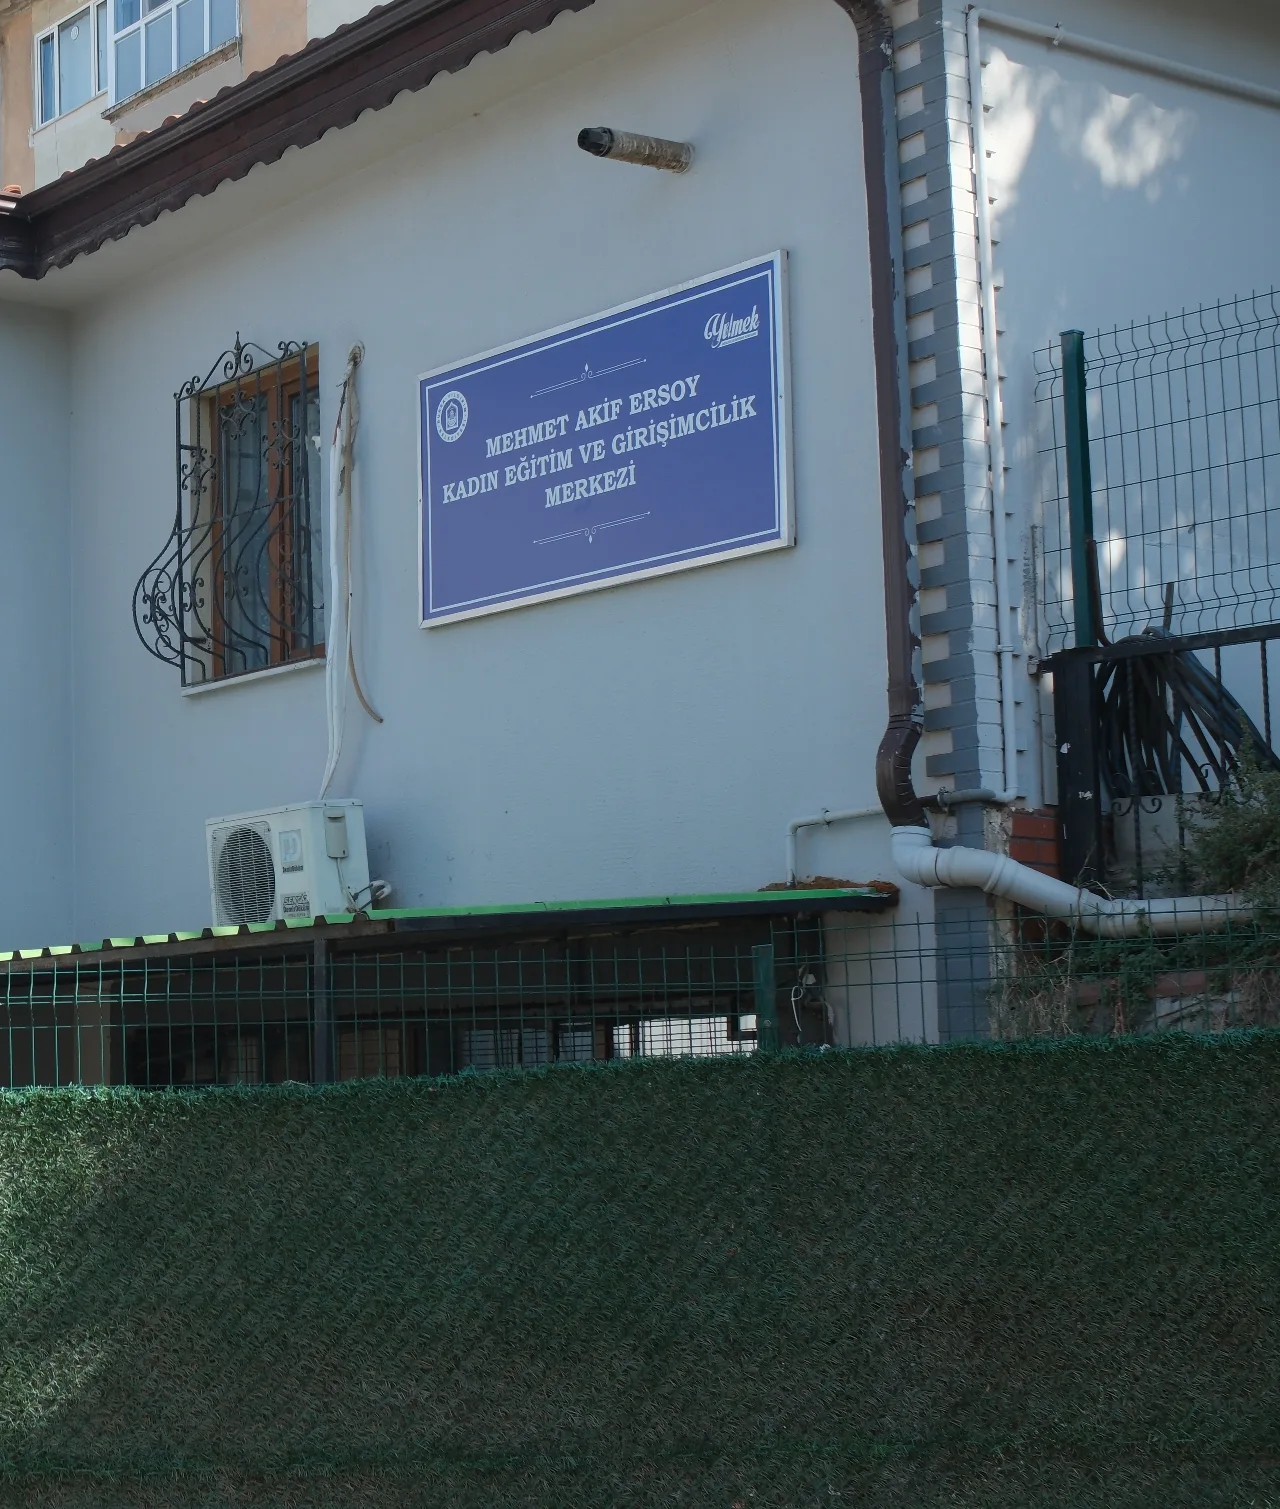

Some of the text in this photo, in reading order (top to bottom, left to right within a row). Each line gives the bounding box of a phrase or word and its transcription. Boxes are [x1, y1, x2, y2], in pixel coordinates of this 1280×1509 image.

[442, 394, 757, 504] KADIN EĞİTİM VE GİRİŞİMCİLİK
[485, 374, 700, 458] MEHMET AKİF ERSOY
[544, 459, 636, 508] MERKEZİ
